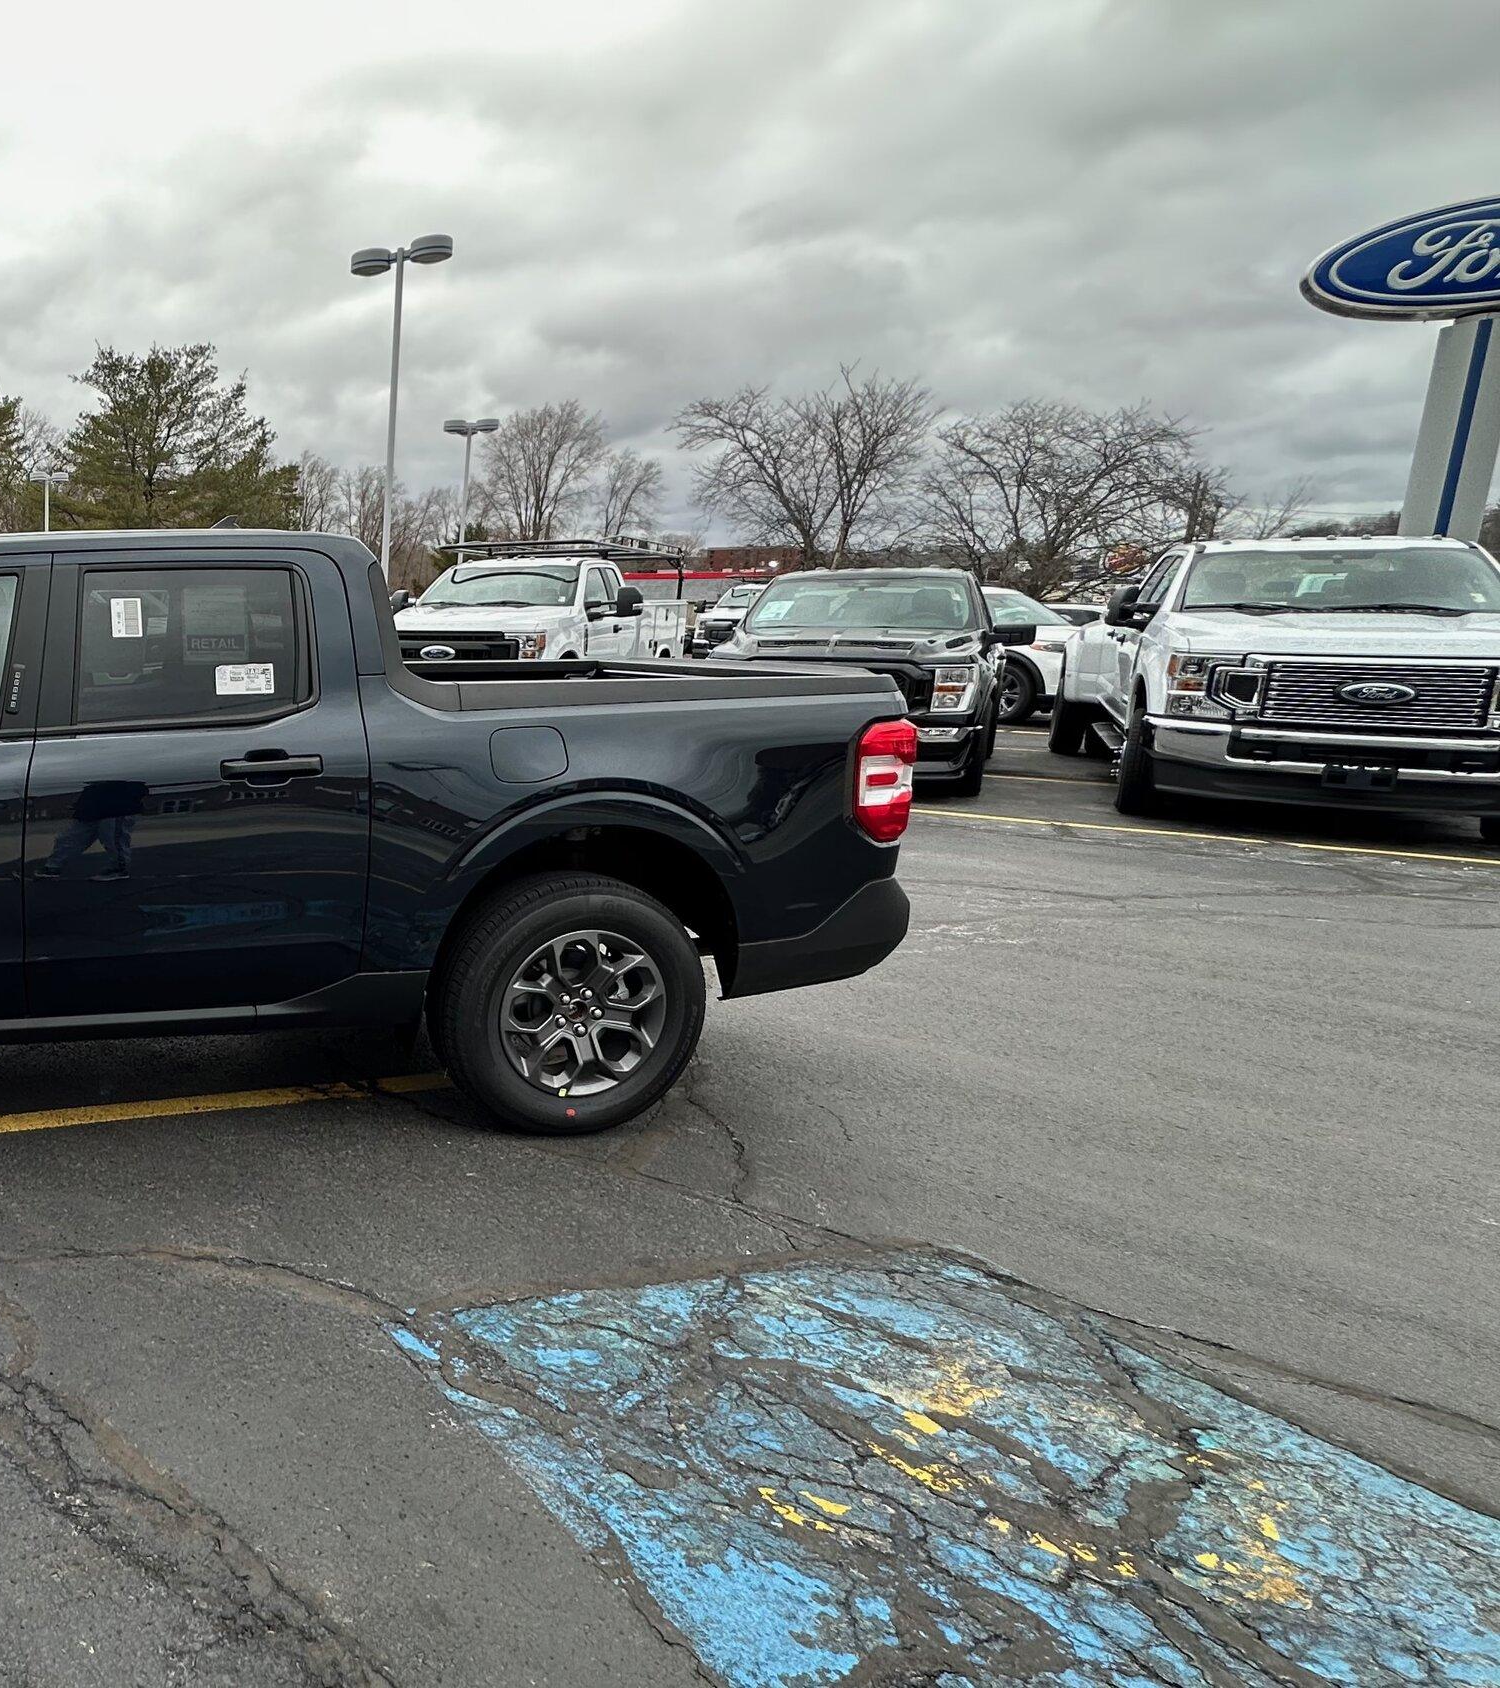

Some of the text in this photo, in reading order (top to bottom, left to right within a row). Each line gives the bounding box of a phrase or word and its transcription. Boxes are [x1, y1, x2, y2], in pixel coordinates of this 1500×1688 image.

[1387, 219, 1500, 291] Fo
[191, 638, 239, 649] RETAIL
[1358, 687, 1398, 699] Ford
